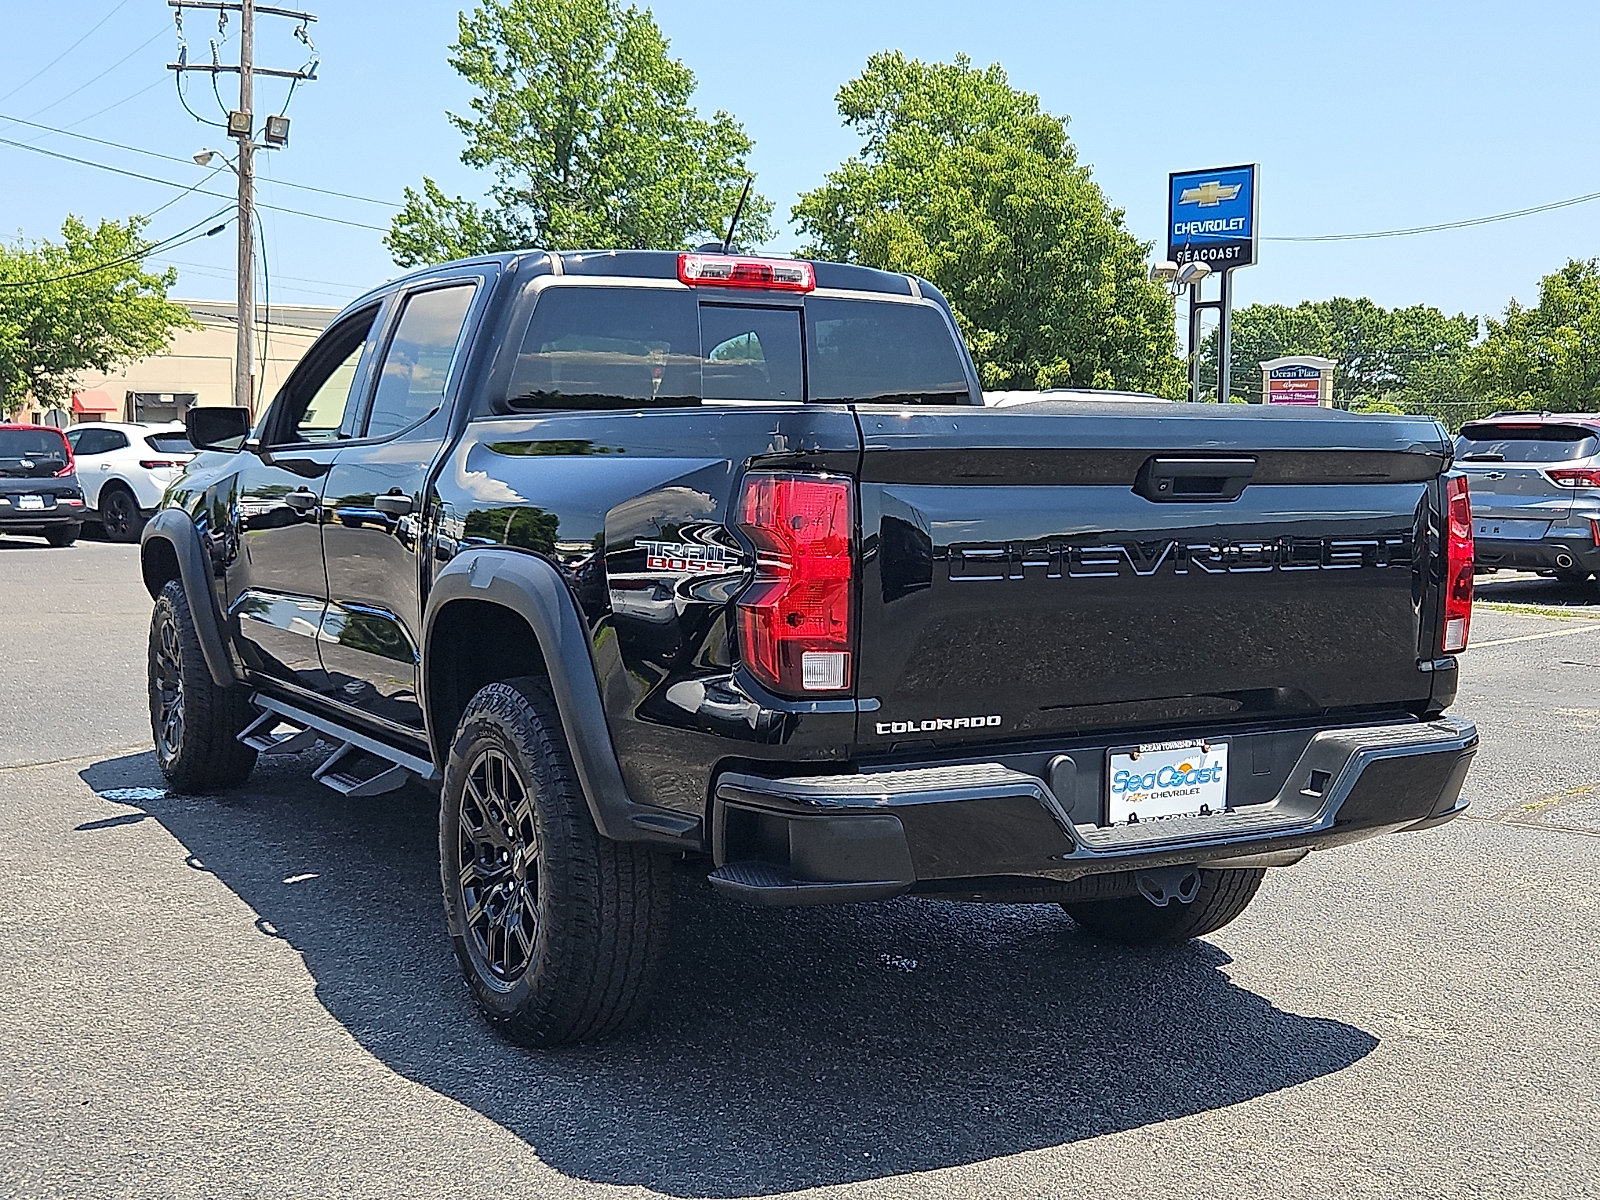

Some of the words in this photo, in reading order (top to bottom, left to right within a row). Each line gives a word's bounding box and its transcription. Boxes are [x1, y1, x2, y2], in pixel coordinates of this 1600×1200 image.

[1174, 217, 1245, 234] CHEVROLET
[1177, 246, 1240, 262] SEACOAST
[1271, 370, 1296, 378] Ocean
[1298, 368, 1319, 377] Plaza
[634, 540, 738, 564] TRAIL
[947, 538, 1404, 581] CHEVROLET
[646, 556, 724, 573] BOSS
[875, 715, 1002, 735] COLORADO
[1139, 742, 1161, 753] OCEAN
[1150, 787, 1201, 800] CHEVROLET
